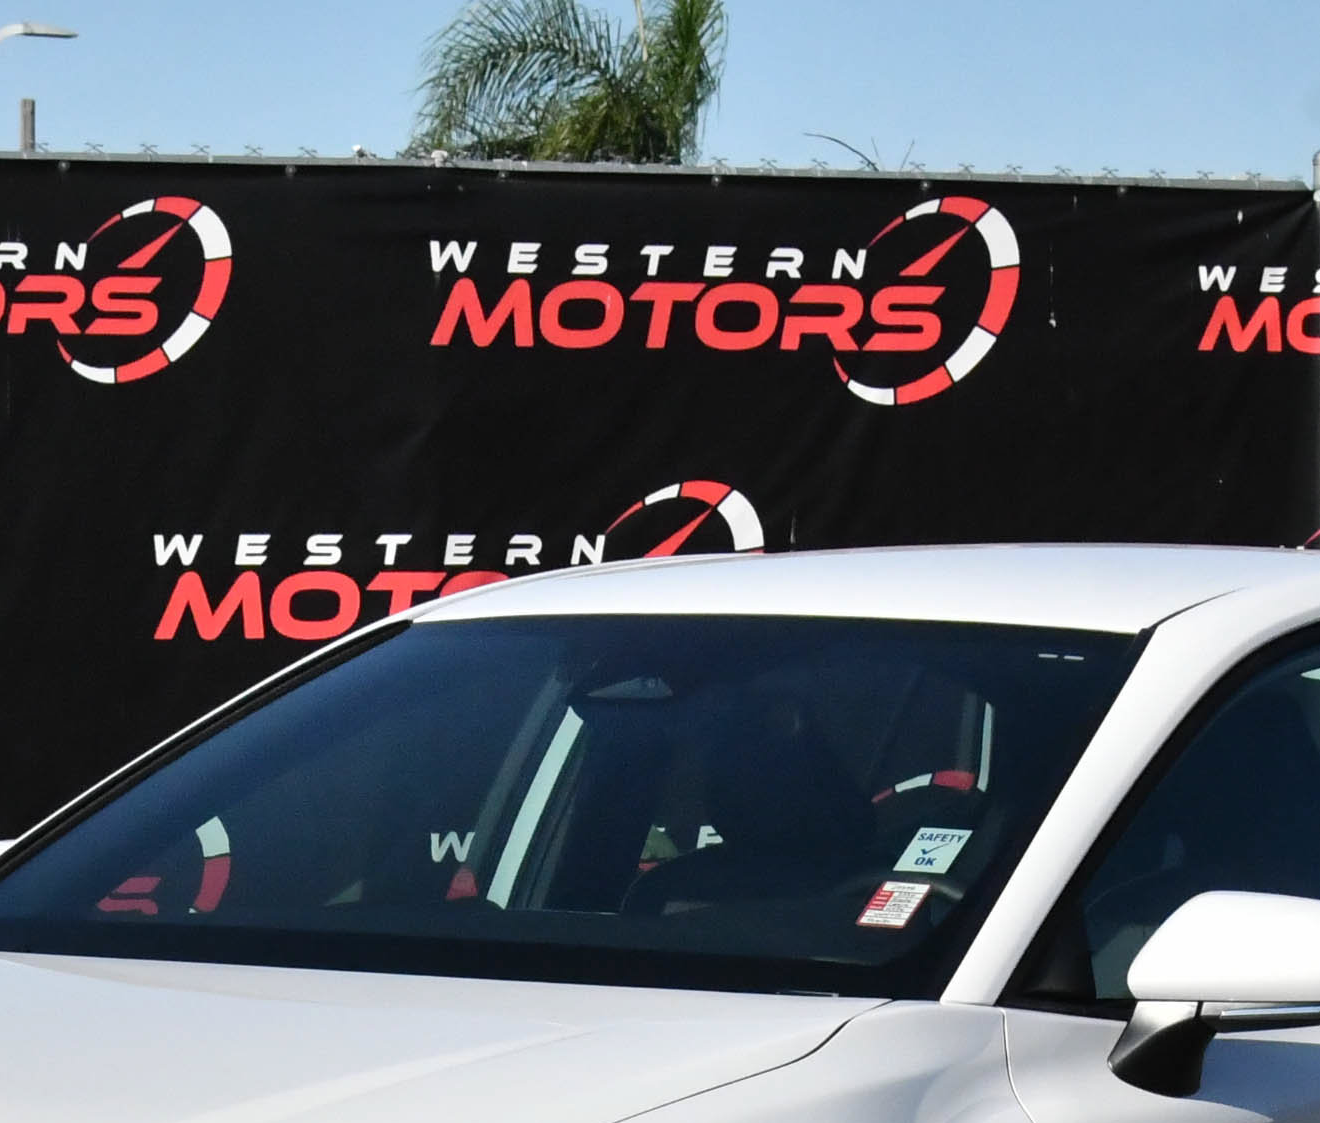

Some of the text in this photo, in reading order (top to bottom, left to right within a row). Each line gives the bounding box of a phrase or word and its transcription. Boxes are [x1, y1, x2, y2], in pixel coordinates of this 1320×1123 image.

[430, 241, 866, 279] WESTERN
[431, 278, 945, 351] MOTORS
[154, 534, 606, 566] WESTERN
[154, 571, 509, 640] MOT
[917, 832, 966, 843] SAFETY
[914, 857, 937, 866] OK
